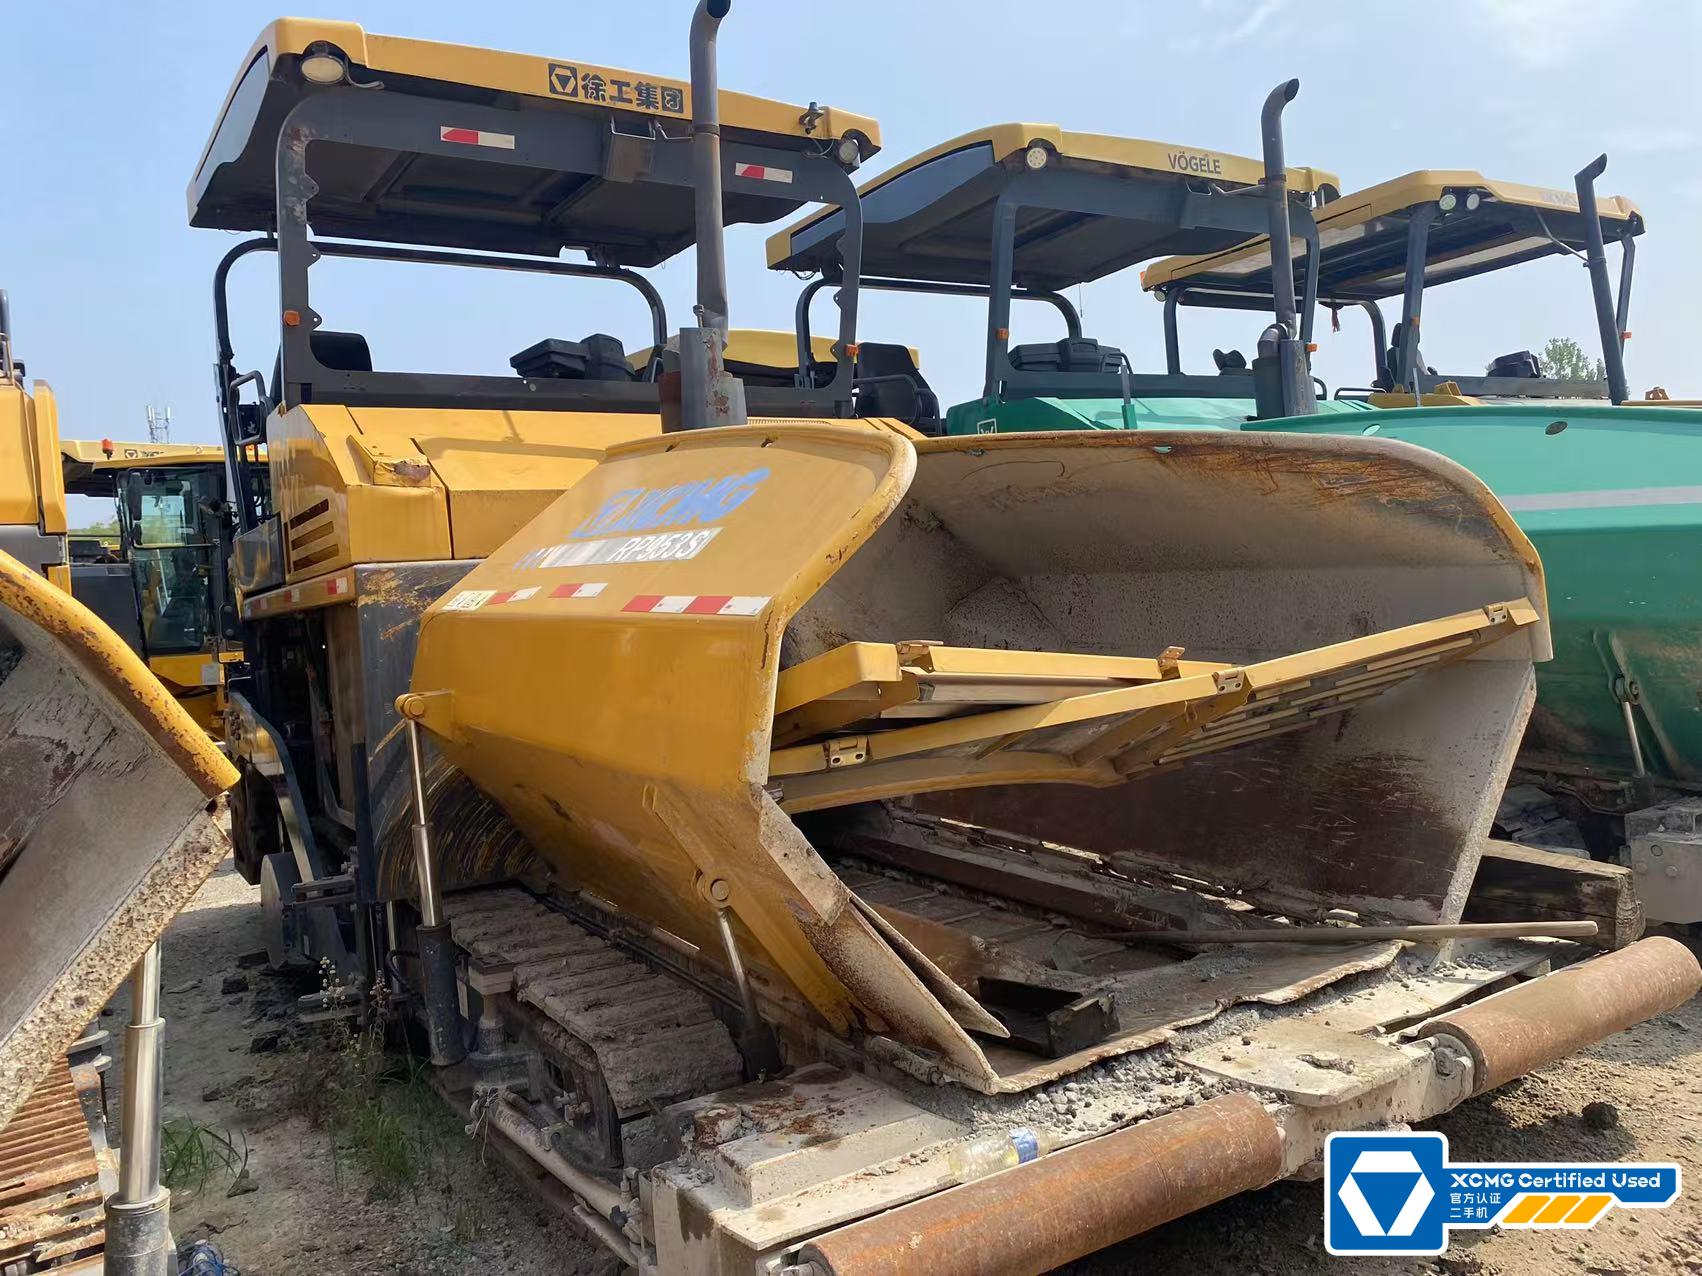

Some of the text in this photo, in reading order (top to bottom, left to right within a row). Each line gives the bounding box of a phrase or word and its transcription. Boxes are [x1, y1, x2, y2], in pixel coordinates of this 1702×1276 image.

[580, 73, 684, 113] 徐工集团
[1167, 151, 1222, 174] VÖGELE
[607, 530, 710, 563] RP953S
